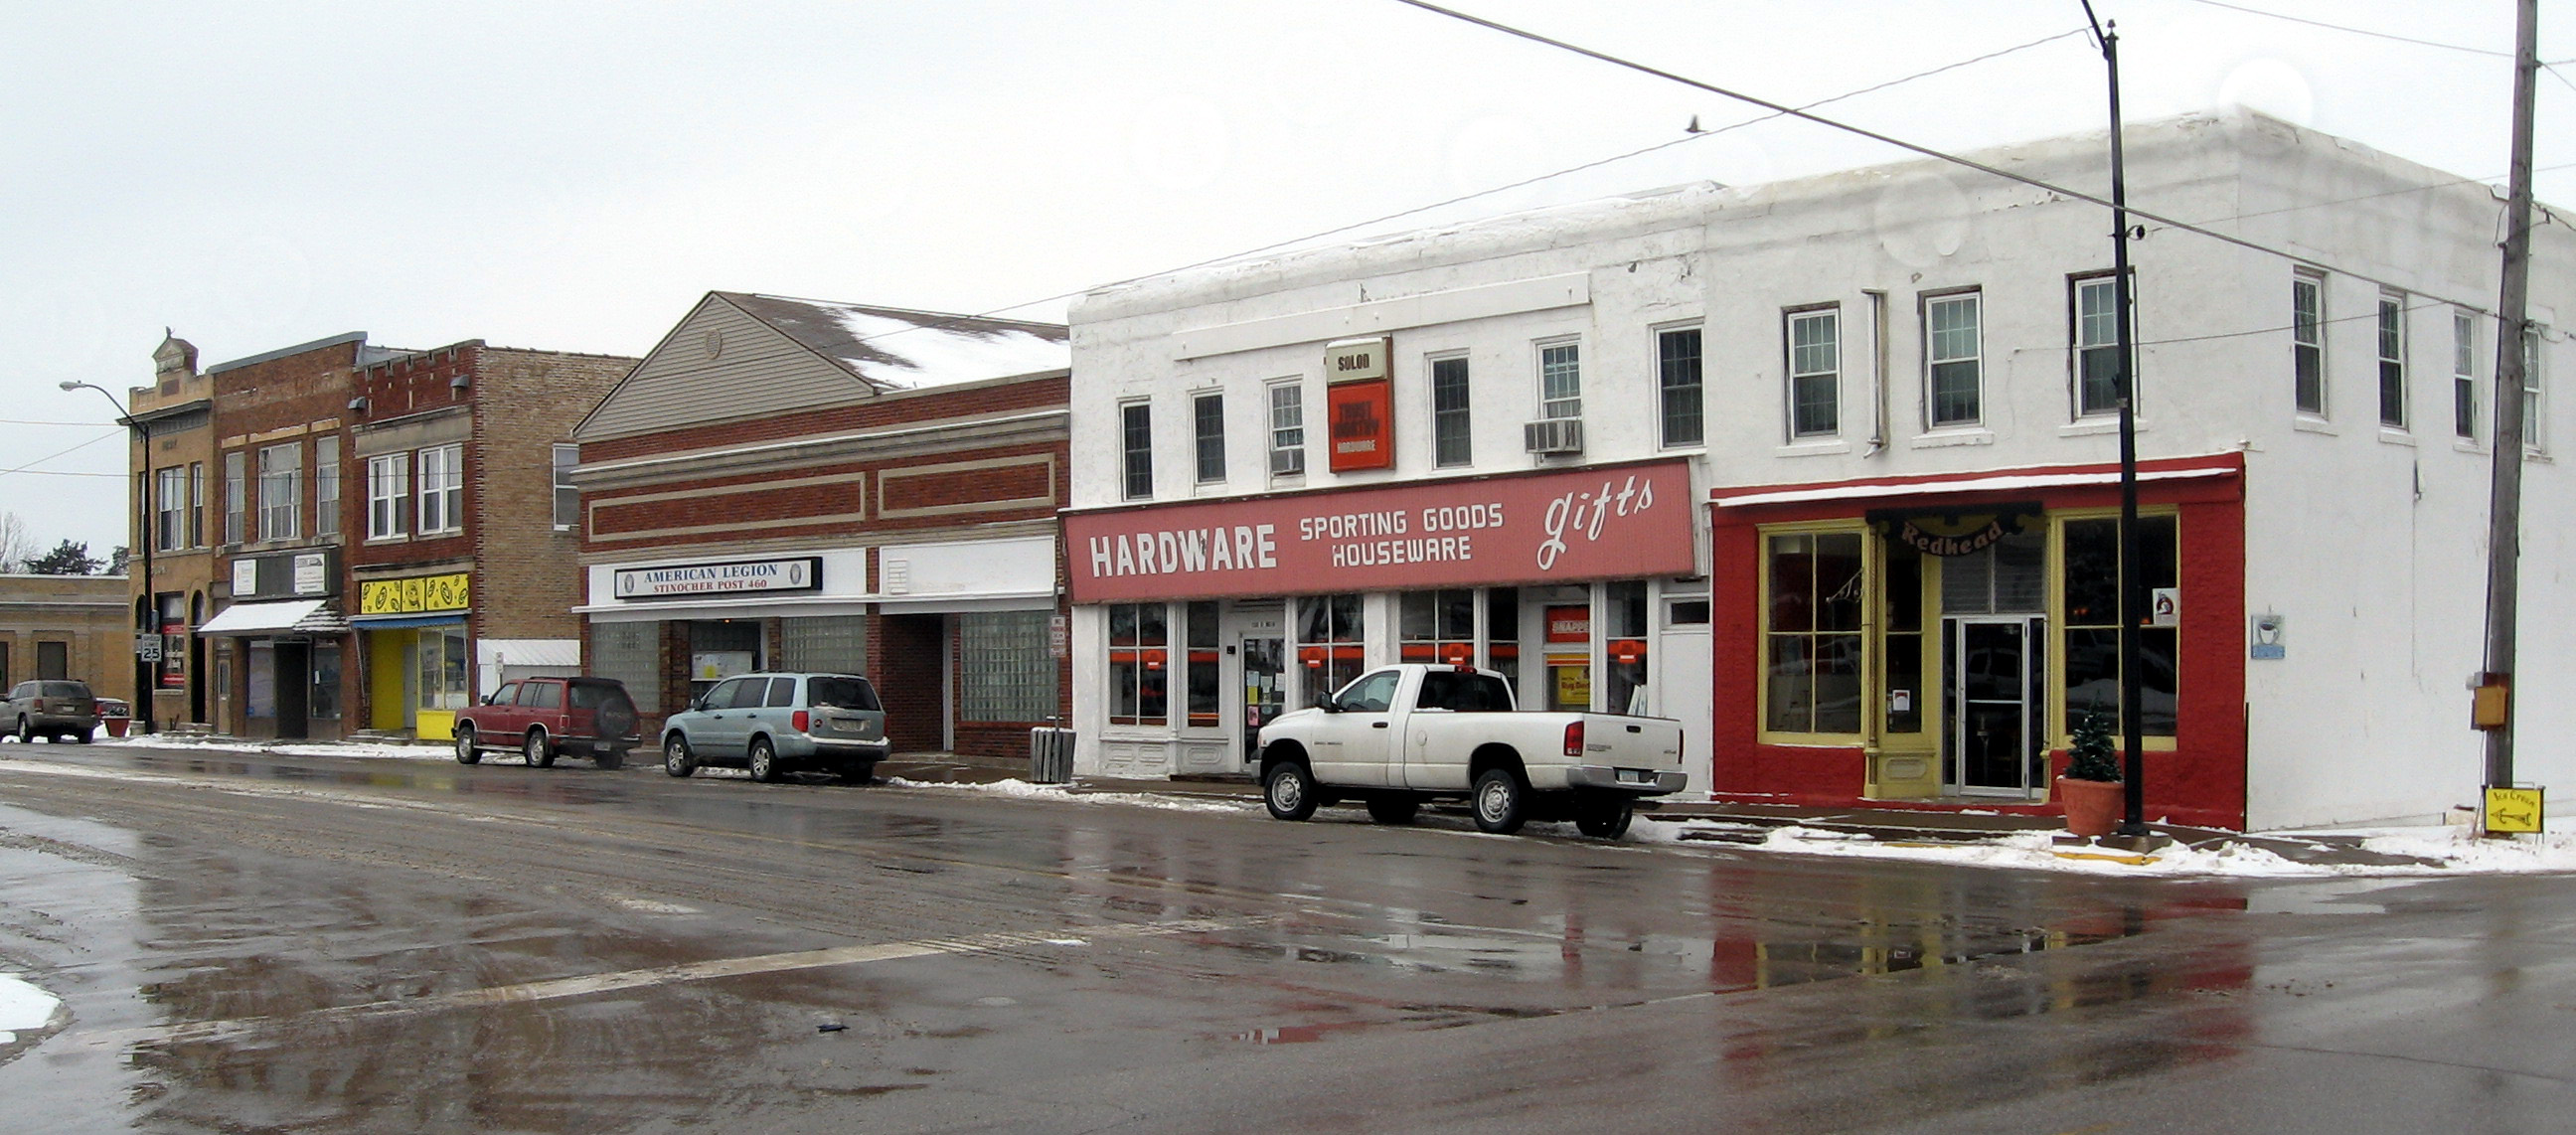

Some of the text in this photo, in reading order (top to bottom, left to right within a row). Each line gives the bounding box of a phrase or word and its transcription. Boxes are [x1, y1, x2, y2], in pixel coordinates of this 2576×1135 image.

[1338, 353, 1370, 371] SOLON
[1299, 502, 1504, 541] SPORTING GOODS
[1536, 475, 1655, 570] gifts
[1089, 523, 1278, 578] HARDWARE
[1332, 535, 1472, 568] HOUSEWARE
[1902, 521, 2003, 556] Redhead
[644, 564, 778, 583] AMERICAN LEGION
[653, 578, 767, 593] STINOCHER POST 460
[143, 647, 160, 659] 25
